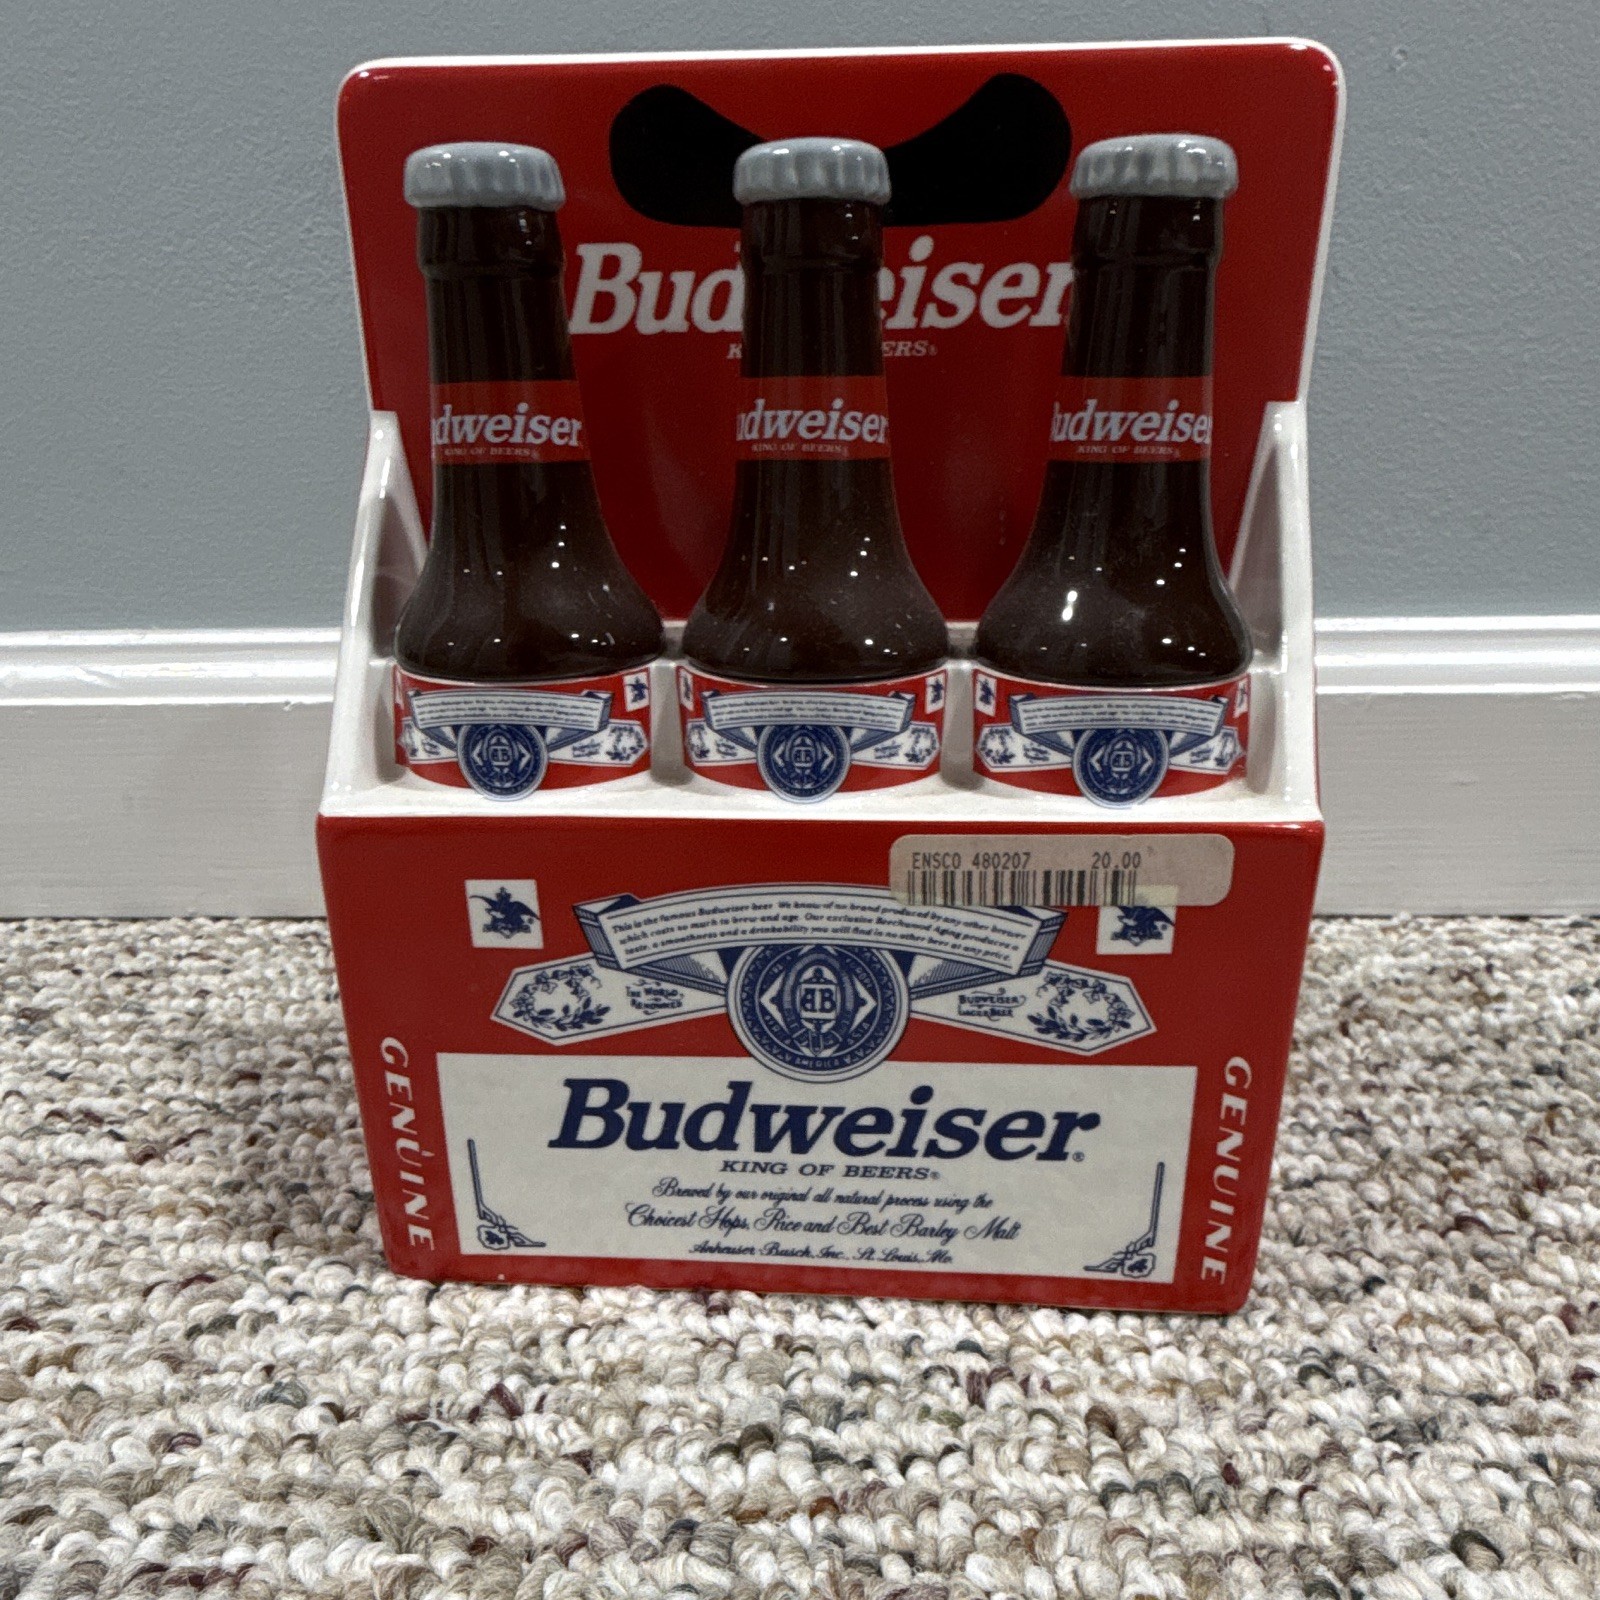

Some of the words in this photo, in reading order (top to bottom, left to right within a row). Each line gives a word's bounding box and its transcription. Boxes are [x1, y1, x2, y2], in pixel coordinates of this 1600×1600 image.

[569, 235, 1075, 335] Budiser
[432, 402, 583, 447] dweiser
[911, 851, 961, 870] ENSCO
[971, 851, 1032, 870] 480207
[1091, 851, 1142, 870] 20.00
[380, 1036, 435, 1251] GENUINE
[719, 1160, 788, 1177] KING
[797, 1163, 835, 1178] OF
[1200, 1056, 1252, 1286] GENUINE
[651, 1176, 715, 1198] Brewed
[716, 1182, 732, 1206] by
[735, 1188, 758, 1200] our
[760, 1186, 812, 1208] original
[812, 1186, 834, 1203] all
[834, 1189, 885, 1207] natural
[879, 1194, 931, 1213] process
[933, 1193, 970, 1215] using
[972, 1191, 993, 1209] the
[624, 1202, 697, 1228] Choicest
[753, 1207, 802, 1232] Rice
[803, 1215, 838, 1234] and
[837, 1211, 890, 1236] Best
[889, 1212, 959, 1247] Barley
[963, 1215, 1022, 1241] Malt
